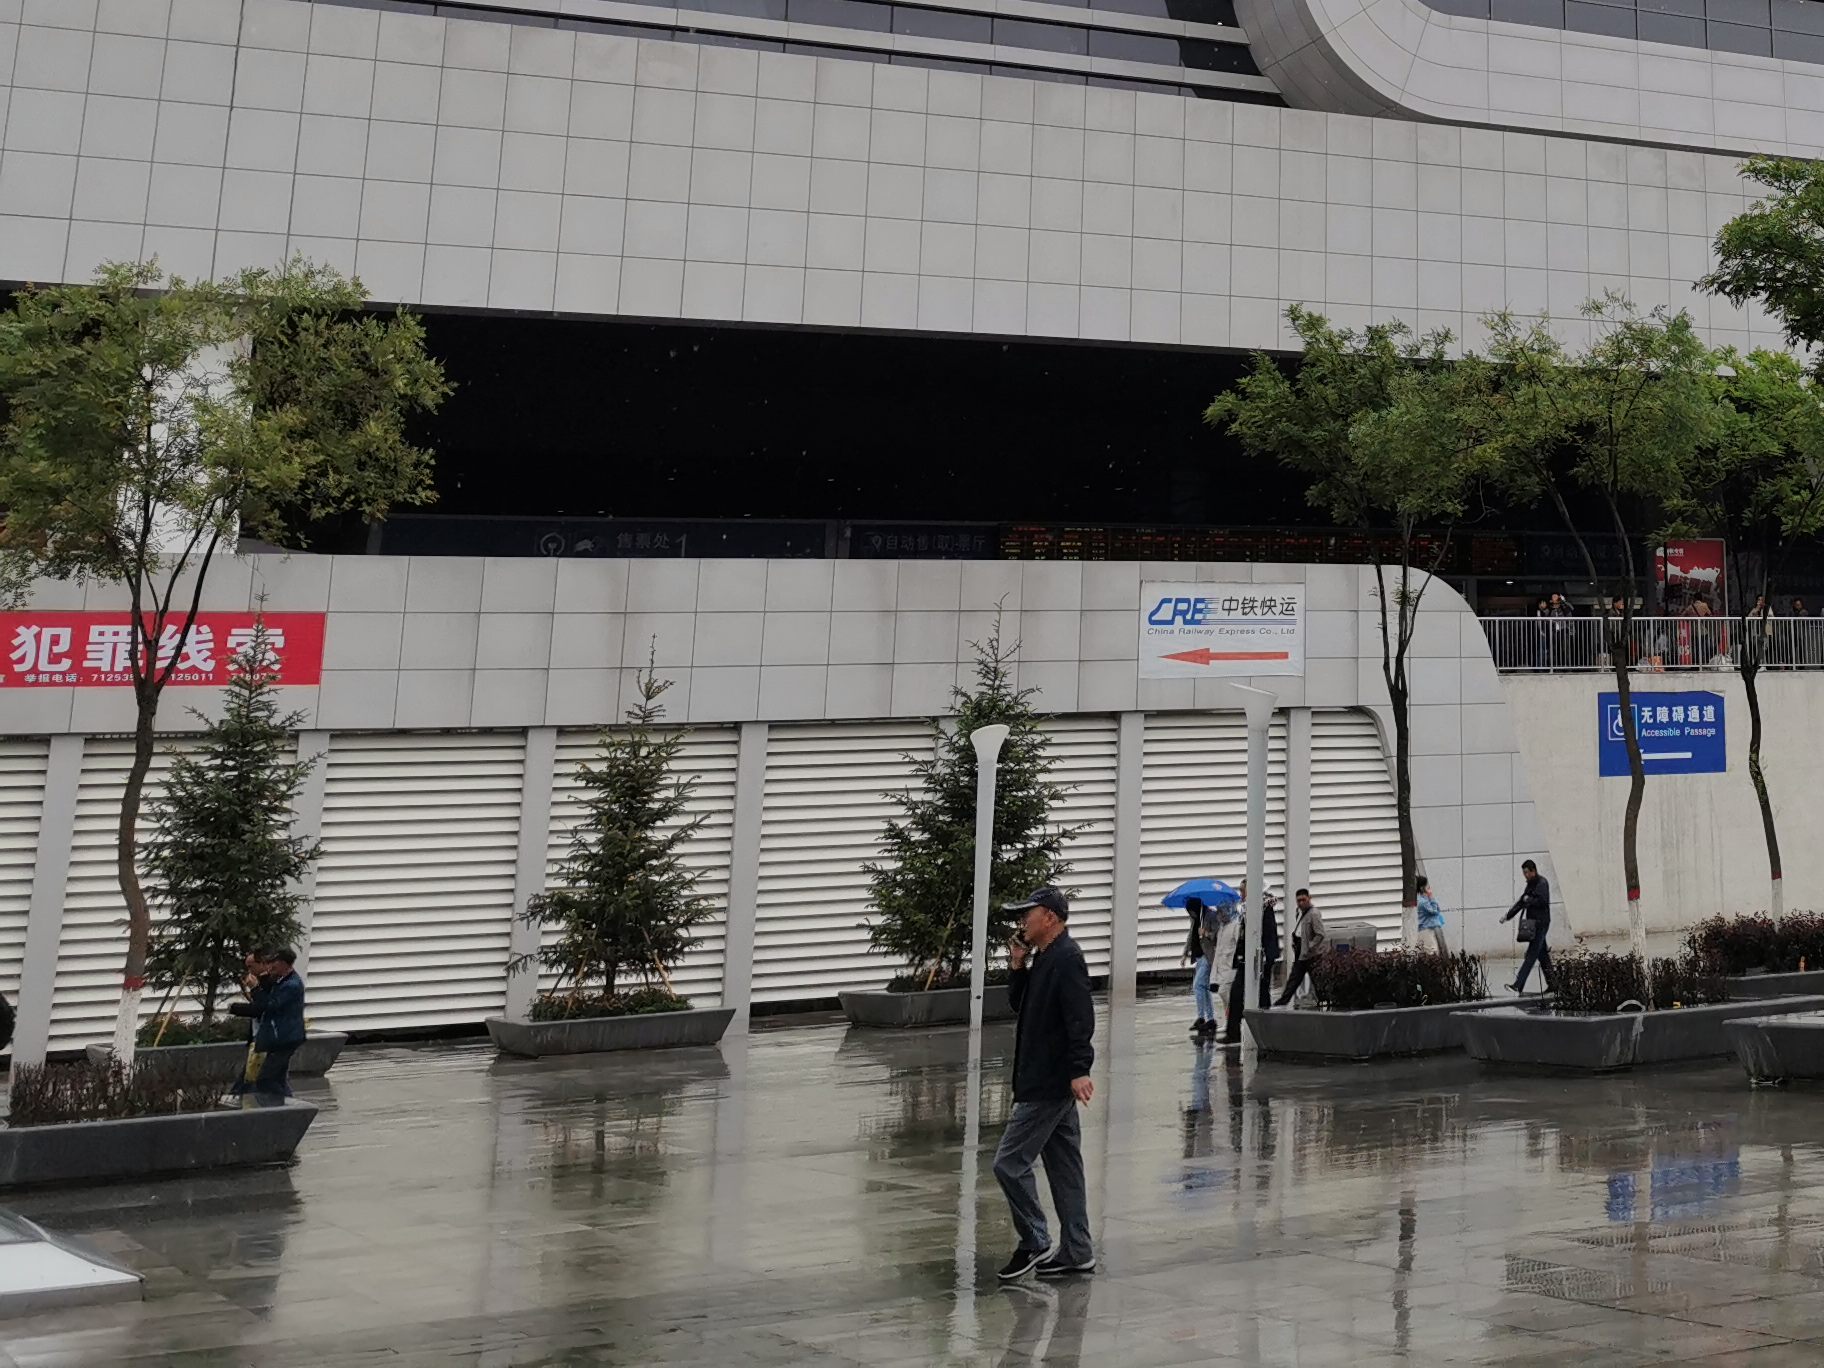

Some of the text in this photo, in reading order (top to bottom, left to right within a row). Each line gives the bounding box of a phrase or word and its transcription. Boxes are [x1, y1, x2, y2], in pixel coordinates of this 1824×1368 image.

[1148, 597, 1214, 626] CRE
[1221, 596, 1297, 617] 中铁快运
[1147, 627, 1174, 635] China
[1178, 627, 1215, 636] Railway
[1218, 627, 1256, 637] Express
[9, 624, 285, 672] 犯罪线索
[164, 673, 213, 681] 125011
[1641, 705, 1716, 724] 无障碍通道
[1641, 727, 1716, 738] Accessible Passage
